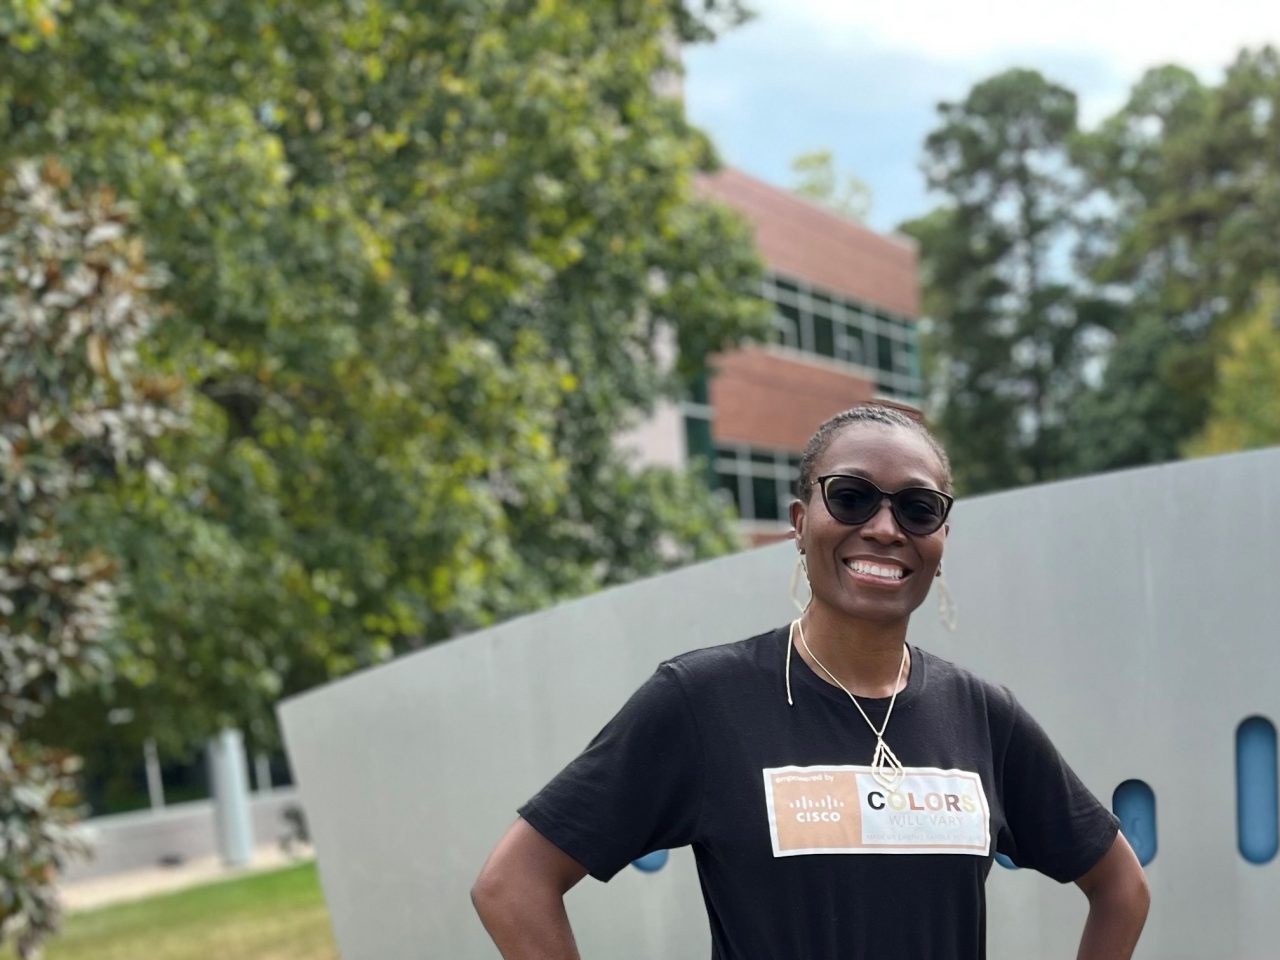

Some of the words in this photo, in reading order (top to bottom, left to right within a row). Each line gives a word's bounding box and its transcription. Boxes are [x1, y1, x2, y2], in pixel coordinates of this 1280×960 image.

[867, 791, 976, 813] COLORS
[795, 811, 841, 823] CISCO
[889, 815, 922, 827] WILL
[929, 815, 964, 827] VARY
